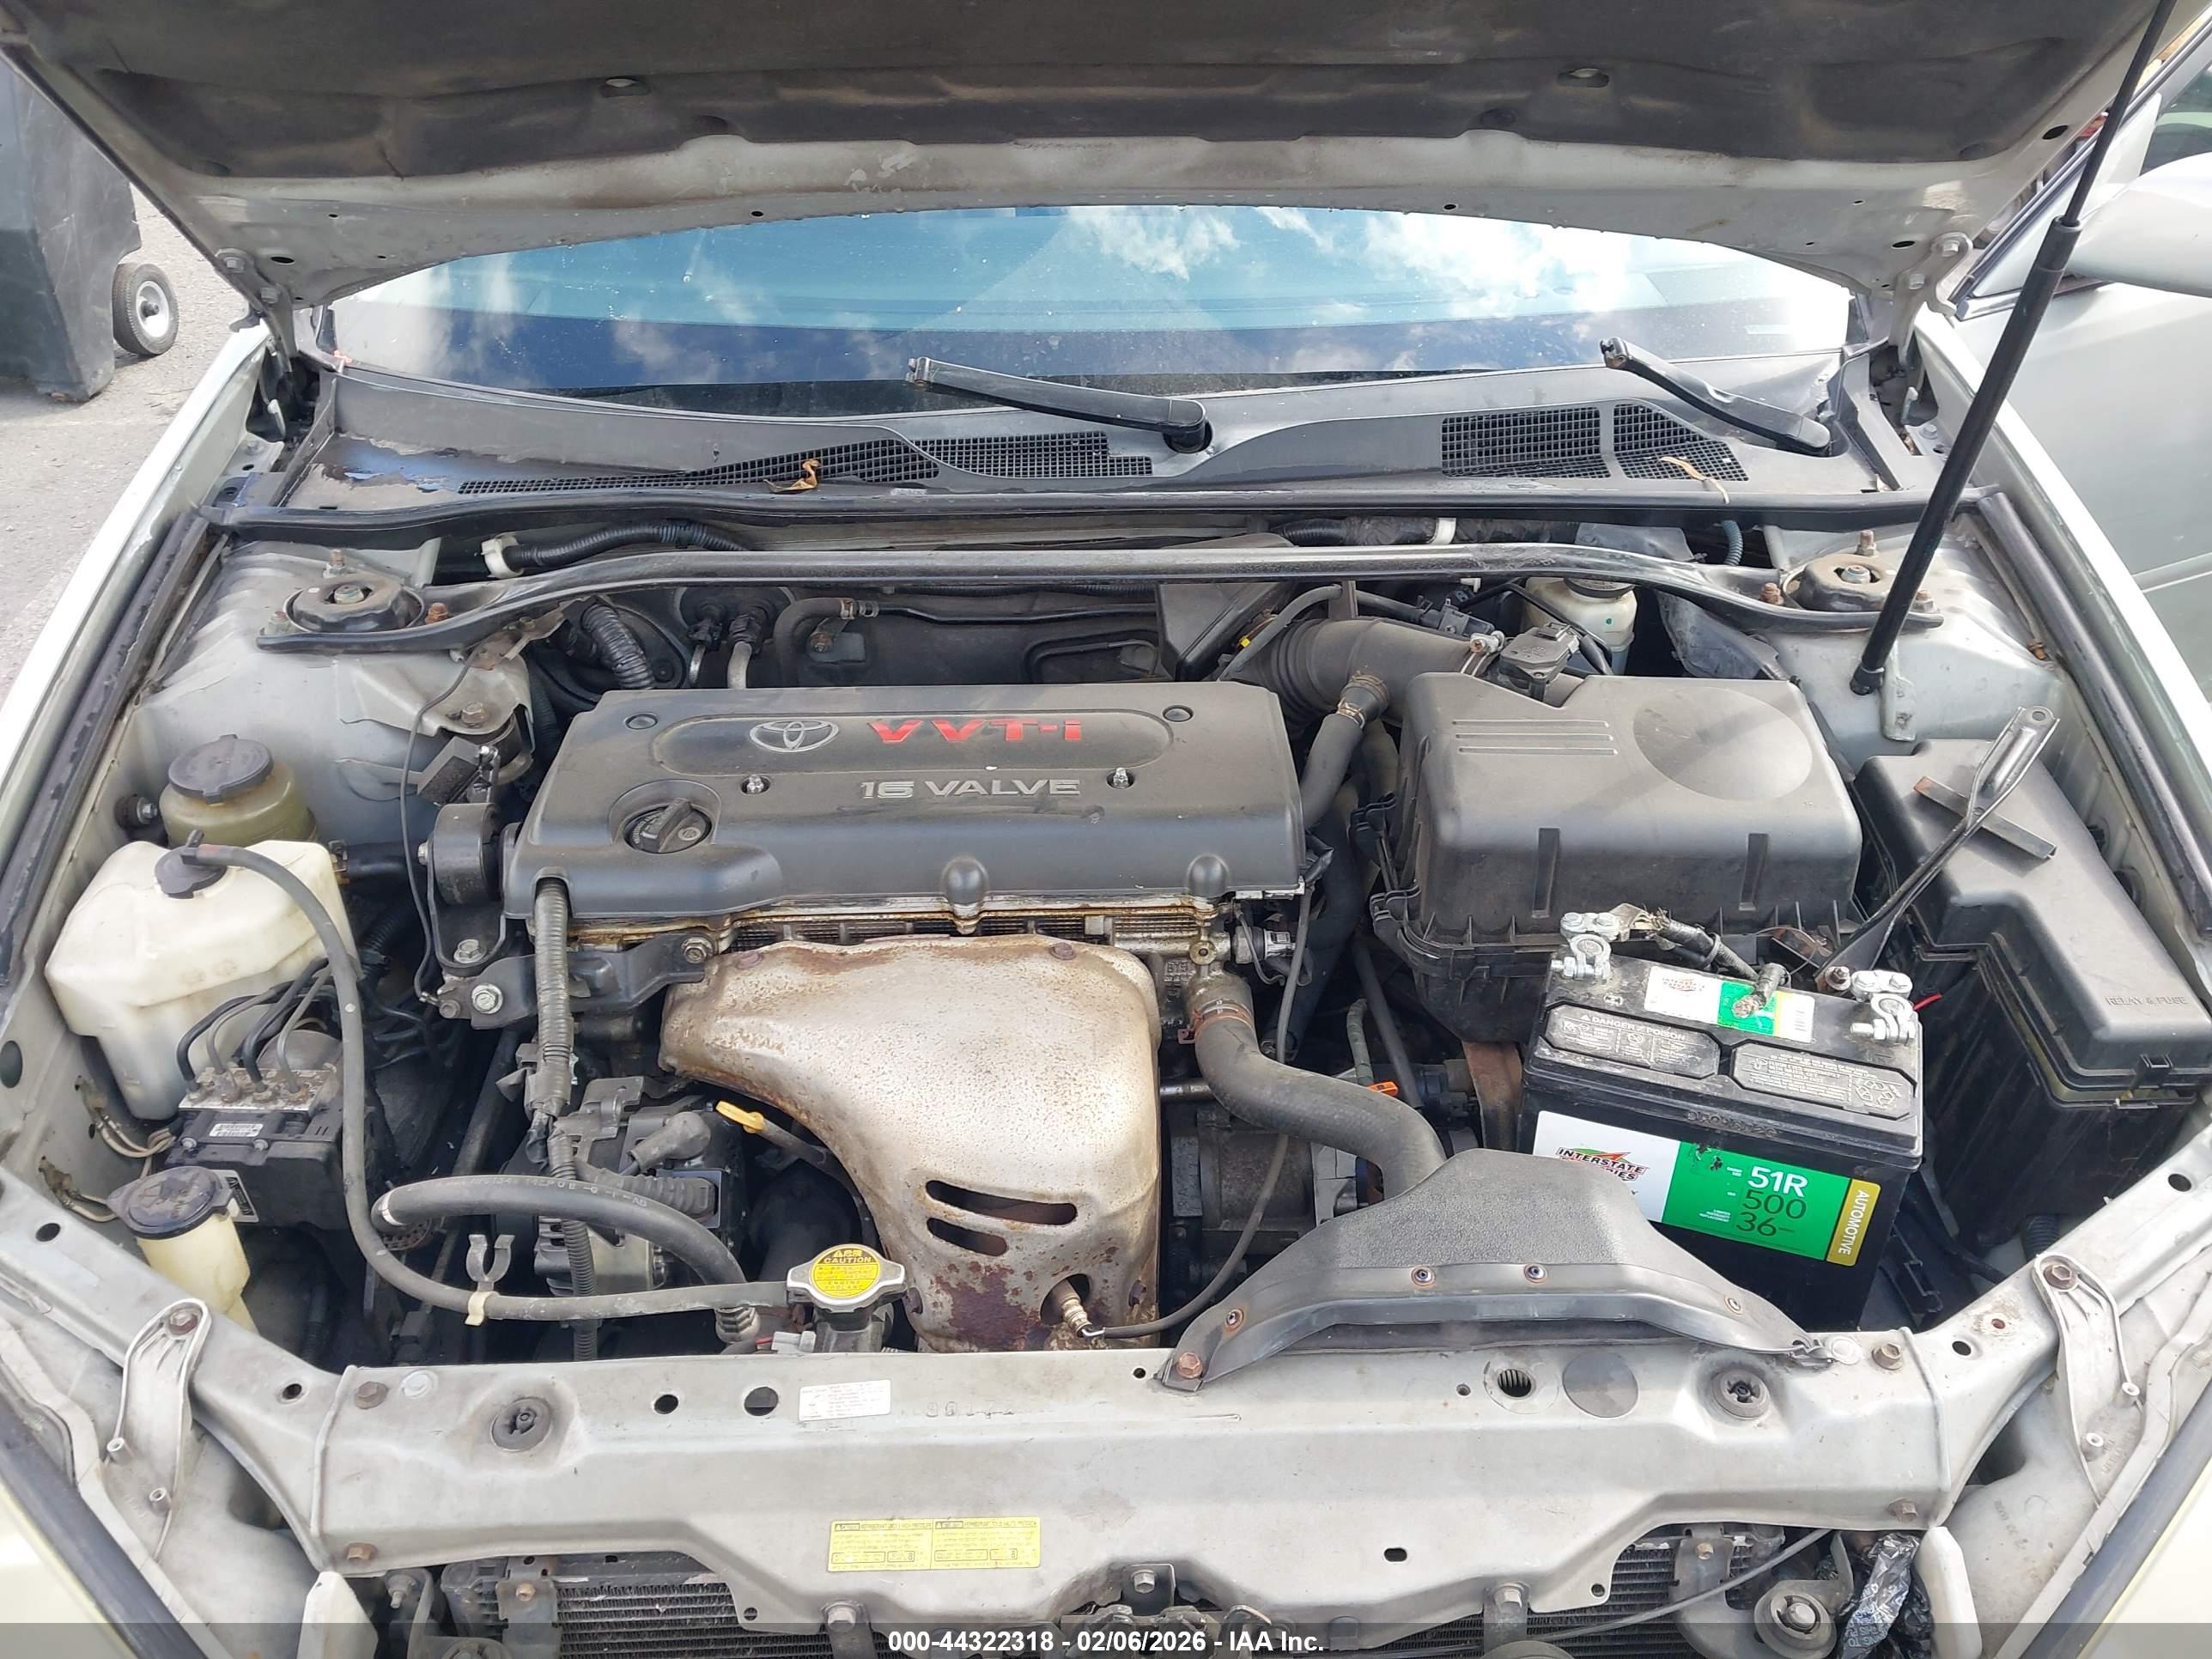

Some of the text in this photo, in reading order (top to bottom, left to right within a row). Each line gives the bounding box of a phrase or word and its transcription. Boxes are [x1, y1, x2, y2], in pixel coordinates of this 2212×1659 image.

[867, 719, 1081, 742] VVT-i
[860, 779, 1081, 799] 16 VALVE
[2105, 995, 2142, 1006] RELAY
[2156, 996, 2189, 1006] FUSE
[1591, 1016, 1636, 1031] DANGER
[1645, 1026, 1686, 1041] POISON
[1558, 1147, 1645, 1175] INTERSTATE
[1747, 1165, 1808, 1198] 51R
[1742, 1188, 1807, 1219] 500
[1838, 1188, 1871, 1255] AUTOMOTIVE
